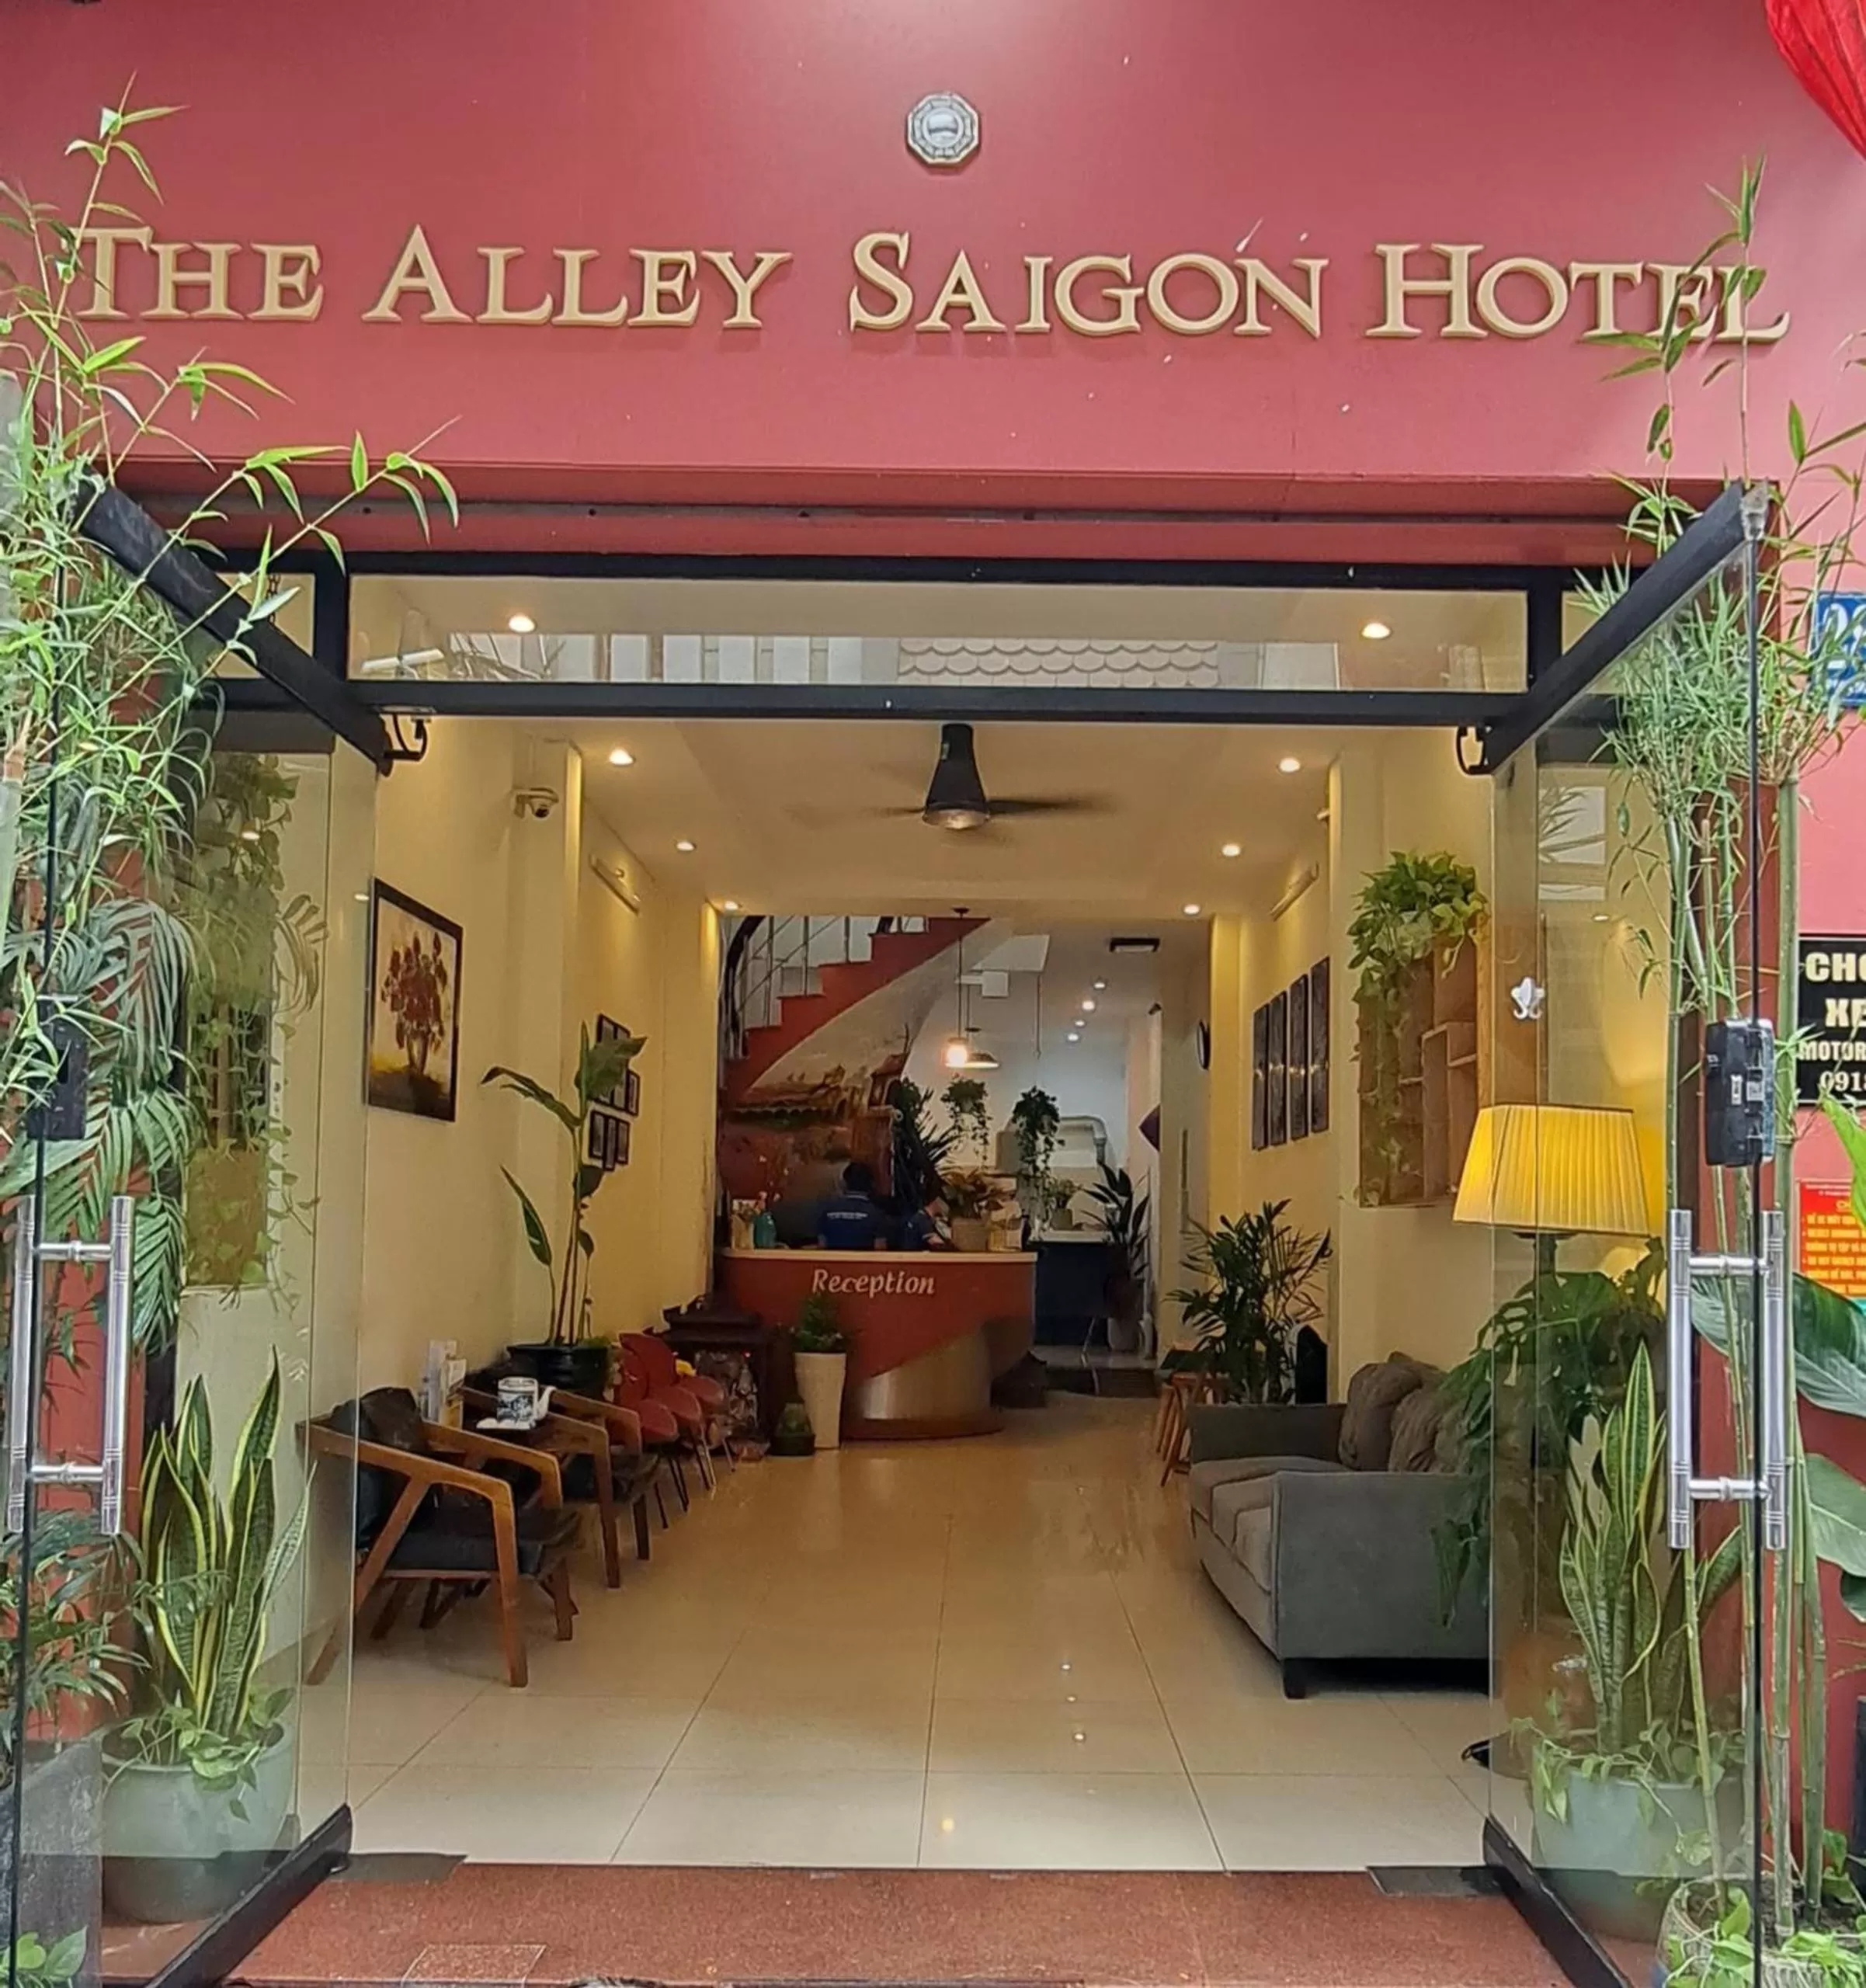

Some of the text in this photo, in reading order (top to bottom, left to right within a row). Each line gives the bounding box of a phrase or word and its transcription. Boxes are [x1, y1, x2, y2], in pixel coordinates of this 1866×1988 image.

[68, 223, 1791, 343] THE ALLEY SAIGON HOTEL
[1819, 1070, 1866, 1092] 091
[812, 1268, 936, 1299] Reception
